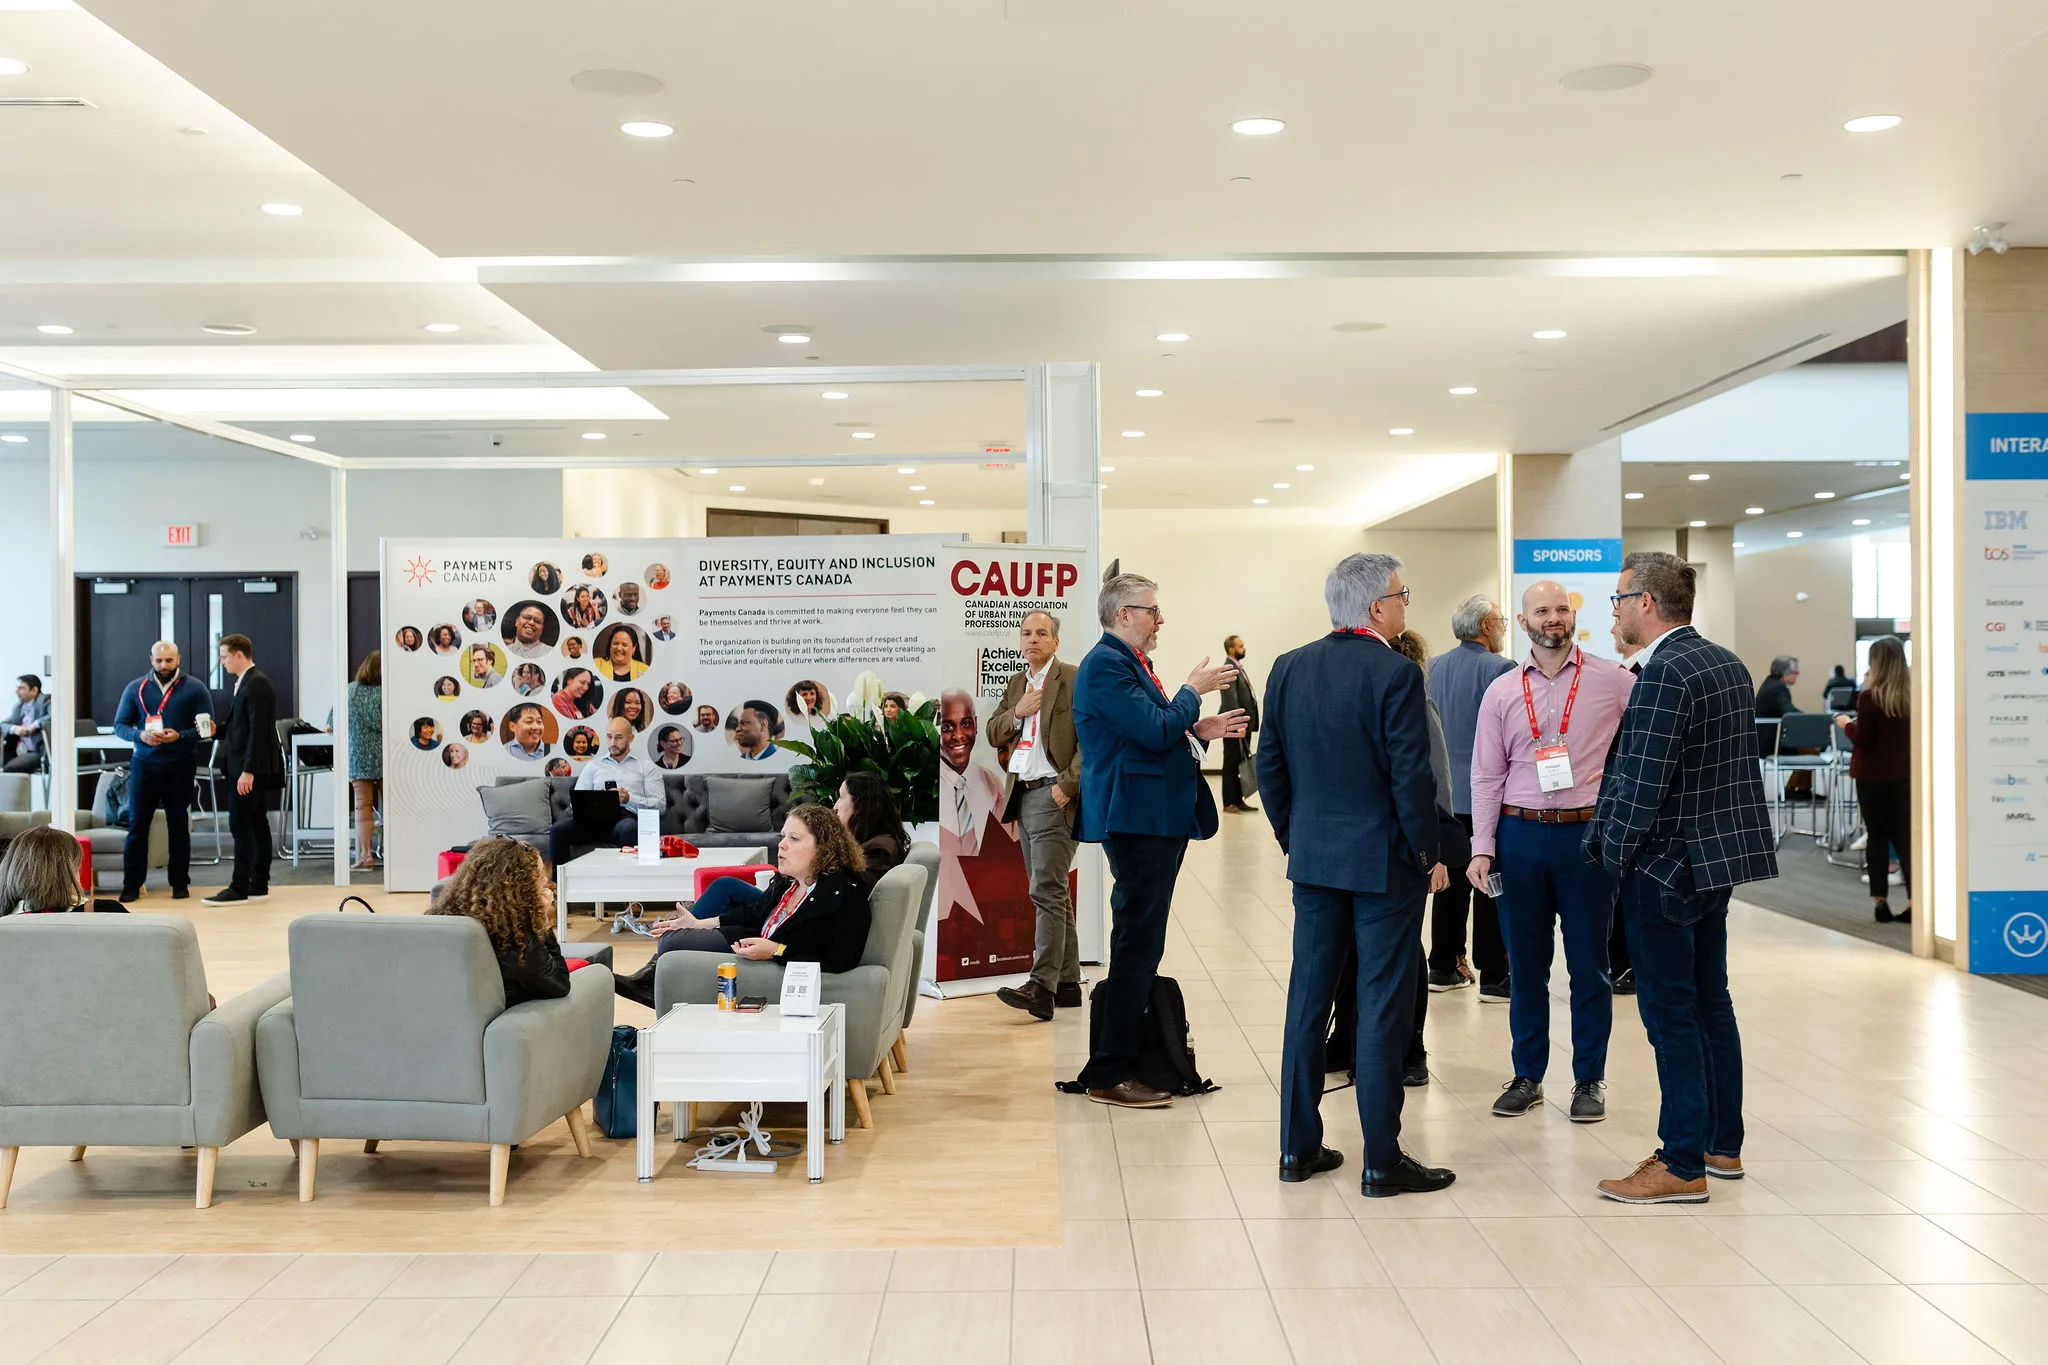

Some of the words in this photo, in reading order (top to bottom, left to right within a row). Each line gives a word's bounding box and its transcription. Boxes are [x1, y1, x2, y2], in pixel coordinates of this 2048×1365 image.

[1990, 437, 2048, 453] INTERA
[1984, 510, 2028, 530] IBM
[168, 526, 192, 544] EXIT
[1533, 549, 1602, 562] SPONSORS
[444, 560, 513, 570] PAYMENTS
[700, 560, 773, 572] DIVERSITY,
[777, 558, 825, 570] EQUITY
[829, 558, 858, 570] AND
[862, 556, 936, 568] INCLUSION
[444, 572, 496, 583] CANADA
[699, 576, 716, 586] AT
[720, 574, 792, 586] PAYMENTS
[796, 573, 852, 586] CANADA
[950, 560, 1078, 598] CAUFP
[965, 600, 1010, 608] CANADIAN
[1012, 601, 1068, 610] ASSOCIATION
[700, 610, 736, 618] Payments
[826, 607, 854, 616] making
[856, 607, 889, 615] everyone
[906, 606, 922, 614] they
[965, 610, 976, 618] OF
[978, 610, 1006, 618] URBAN
[1008, 610, 1028, 618] FINA
[964, 620, 1020, 628] PROFESSIONA
[1985, 622, 2006, 632] CGI
[715, 638, 760, 646] organization
[771, 638, 800, 646] building
[700, 648, 746, 656] appreciation
[760, 648, 791, 656] diversity
[852, 646, 894, 654] collectively
[895, 646, 924, 654] creating
[982, 648, 1024, 659] Achiev
[750, 658, 784, 666] equitable
[896, 655, 922, 663] valued.
[982, 660, 1030, 672] Excellen
[981, 673, 1008, 684] Thro
